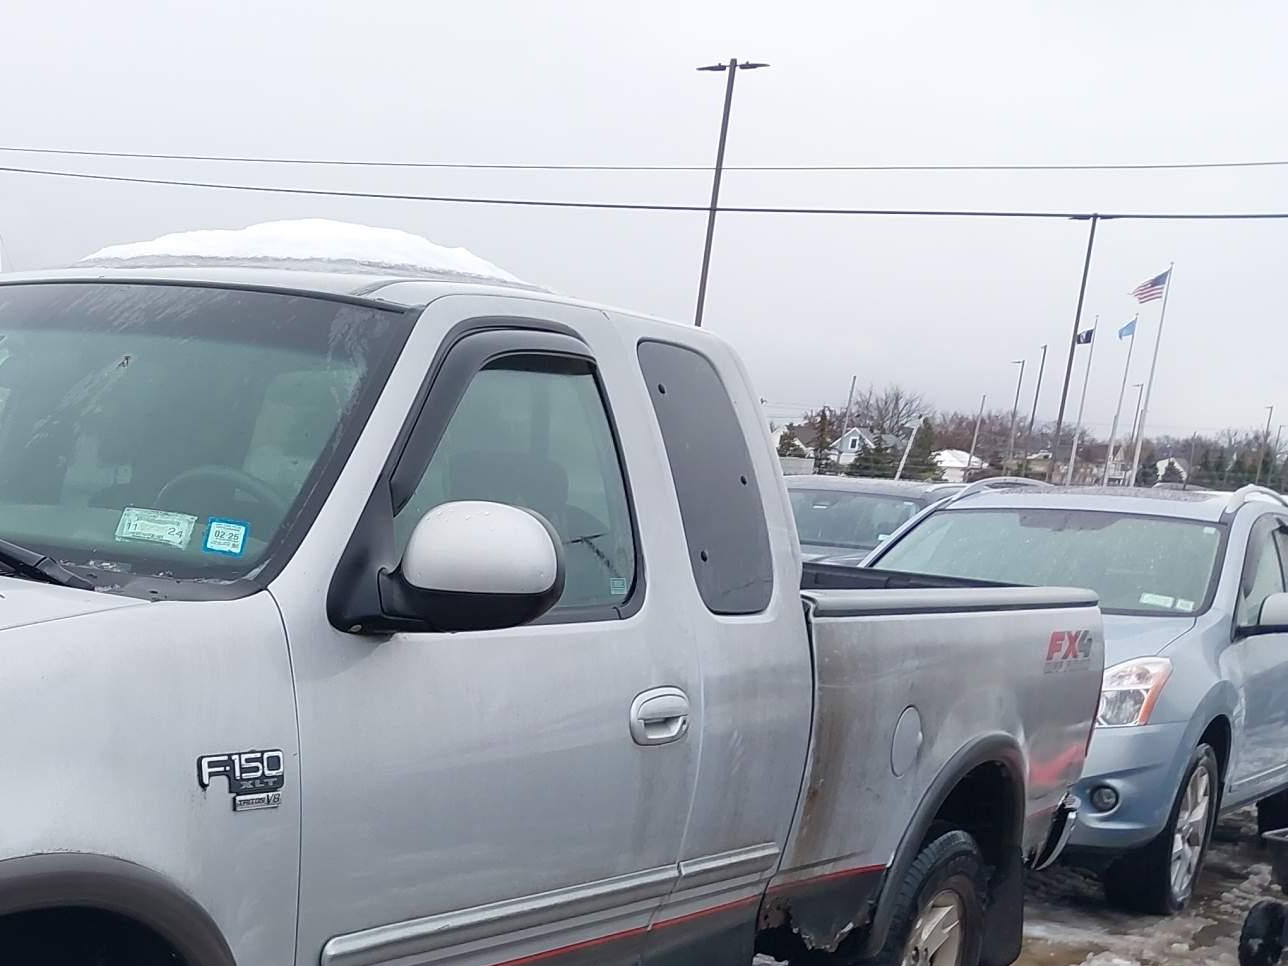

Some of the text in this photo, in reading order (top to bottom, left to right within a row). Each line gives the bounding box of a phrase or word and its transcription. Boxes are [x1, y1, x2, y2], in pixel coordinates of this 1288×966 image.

[1045, 629, 1093, 661] FX4
[240, 777, 279, 789] XLT
[266, 793, 282, 805] V8
